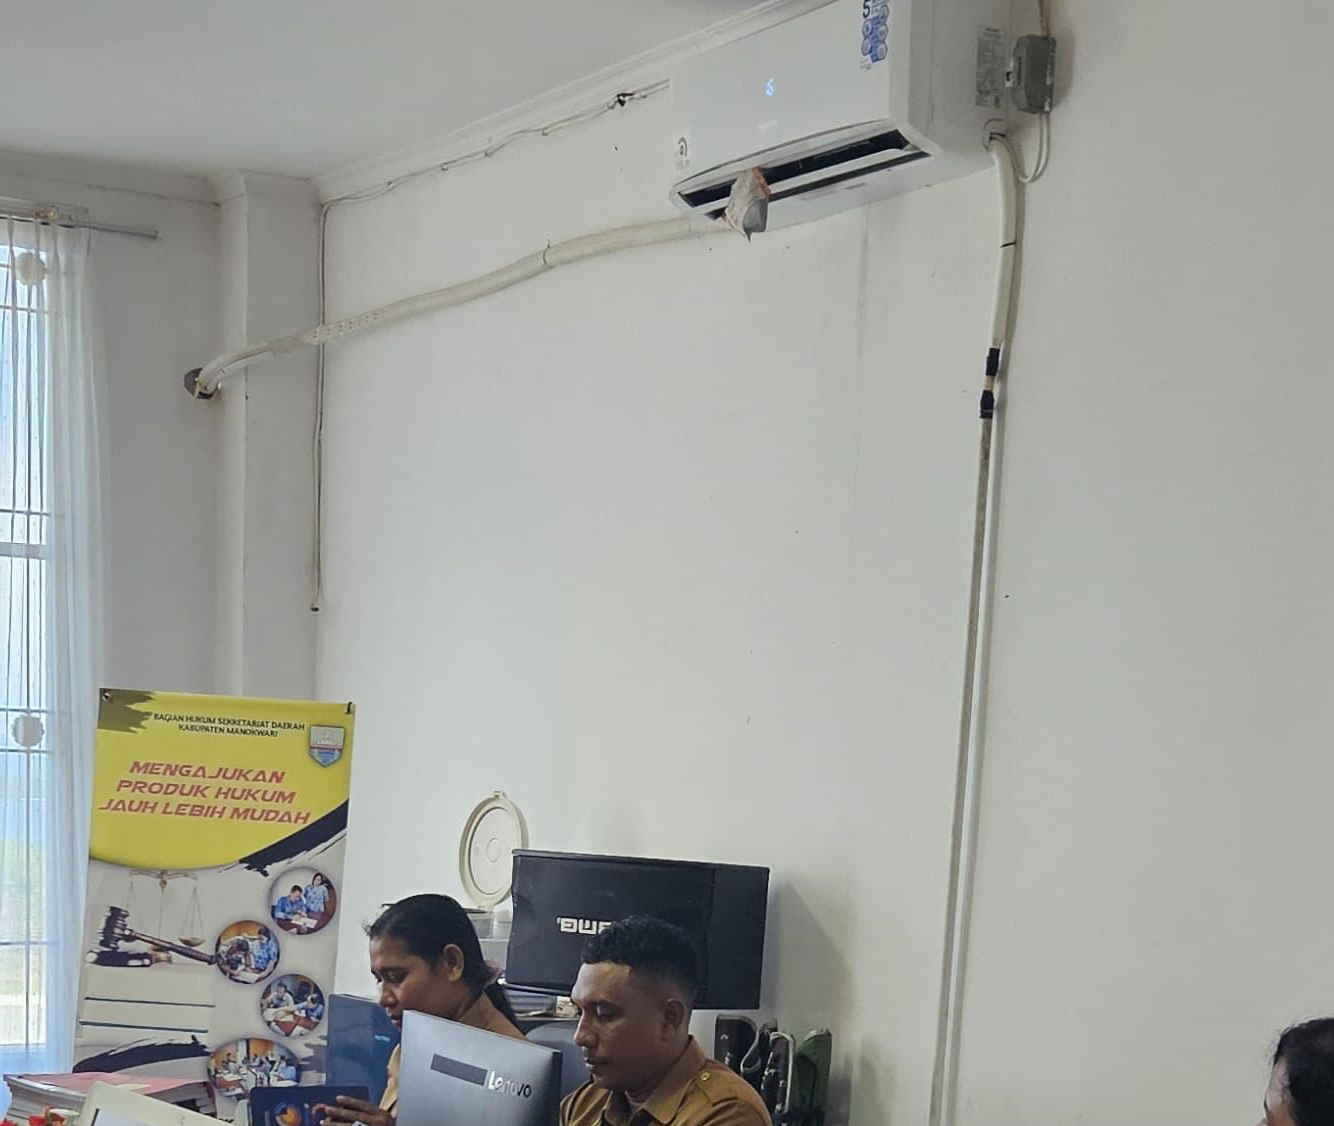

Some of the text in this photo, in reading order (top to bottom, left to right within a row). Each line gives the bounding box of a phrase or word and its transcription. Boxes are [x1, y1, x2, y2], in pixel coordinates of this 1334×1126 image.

[153, 712, 305, 731] BAGIAN HUKUM SEKRETARIAT DAERAH
[178, 724, 278, 738] KABUPATEN MANOKWARI
[129, 760, 286, 785] MENGAJUKAN
[116, 779, 297, 805] PRODUK HUKUM
[99, 798, 311, 825] JAUH LEBIH MUDAH
[487, 1070, 533, 1099] Lenovo
